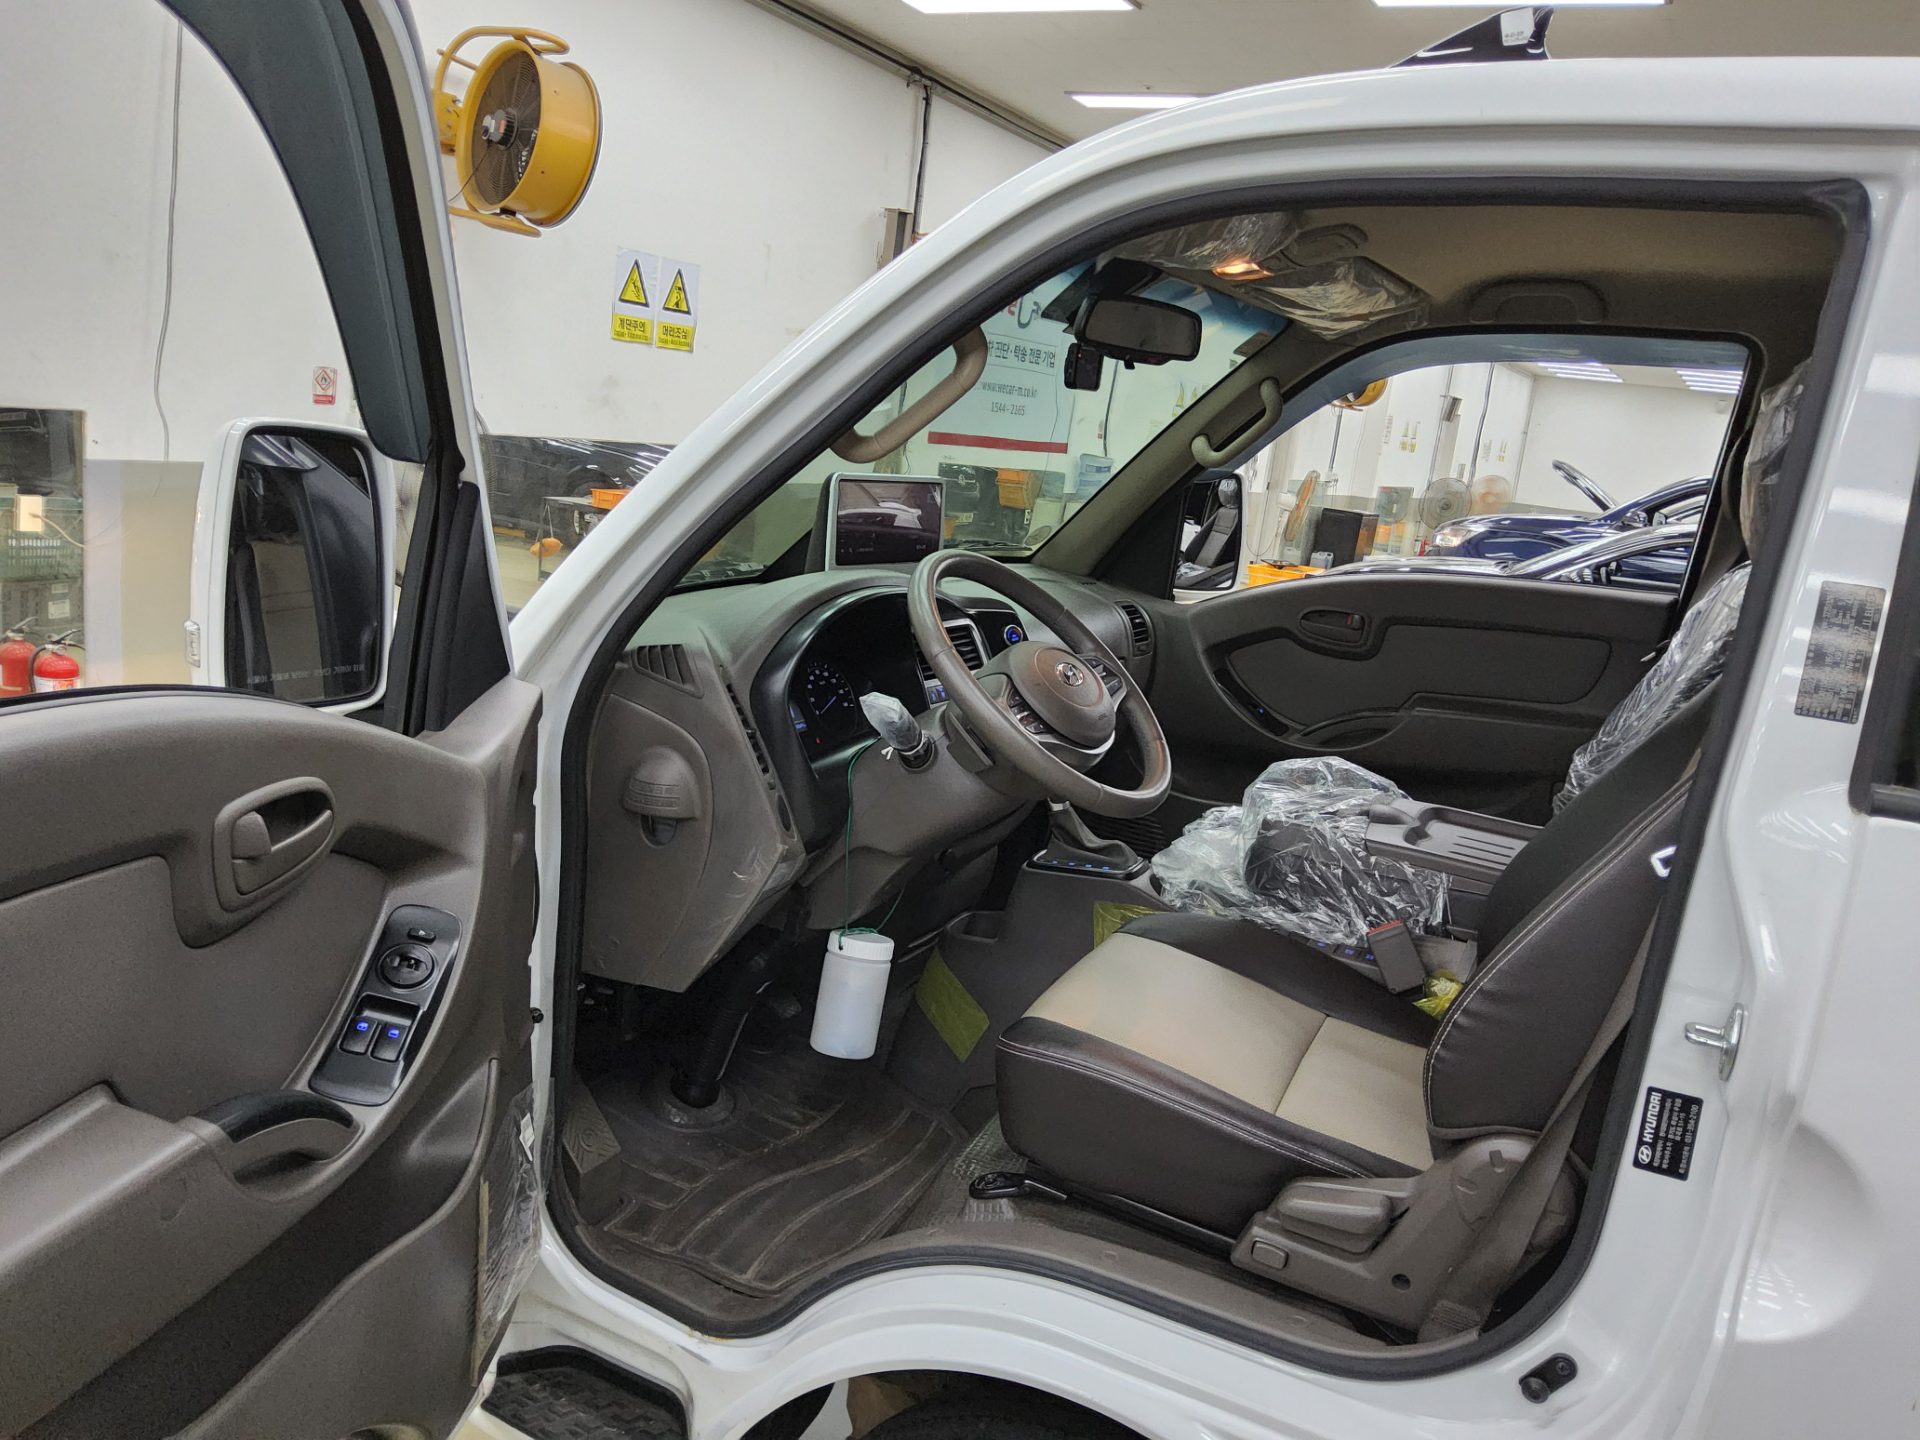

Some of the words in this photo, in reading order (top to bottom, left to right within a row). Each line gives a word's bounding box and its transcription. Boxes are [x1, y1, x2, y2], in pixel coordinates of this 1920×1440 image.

[662, 324, 688, 340] 머리조심
[1028, 345, 1042, 365] 전문
[1042, 349, 1056, 369] 기업
[1642, 1092, 1663, 1143] HYUNDAI
